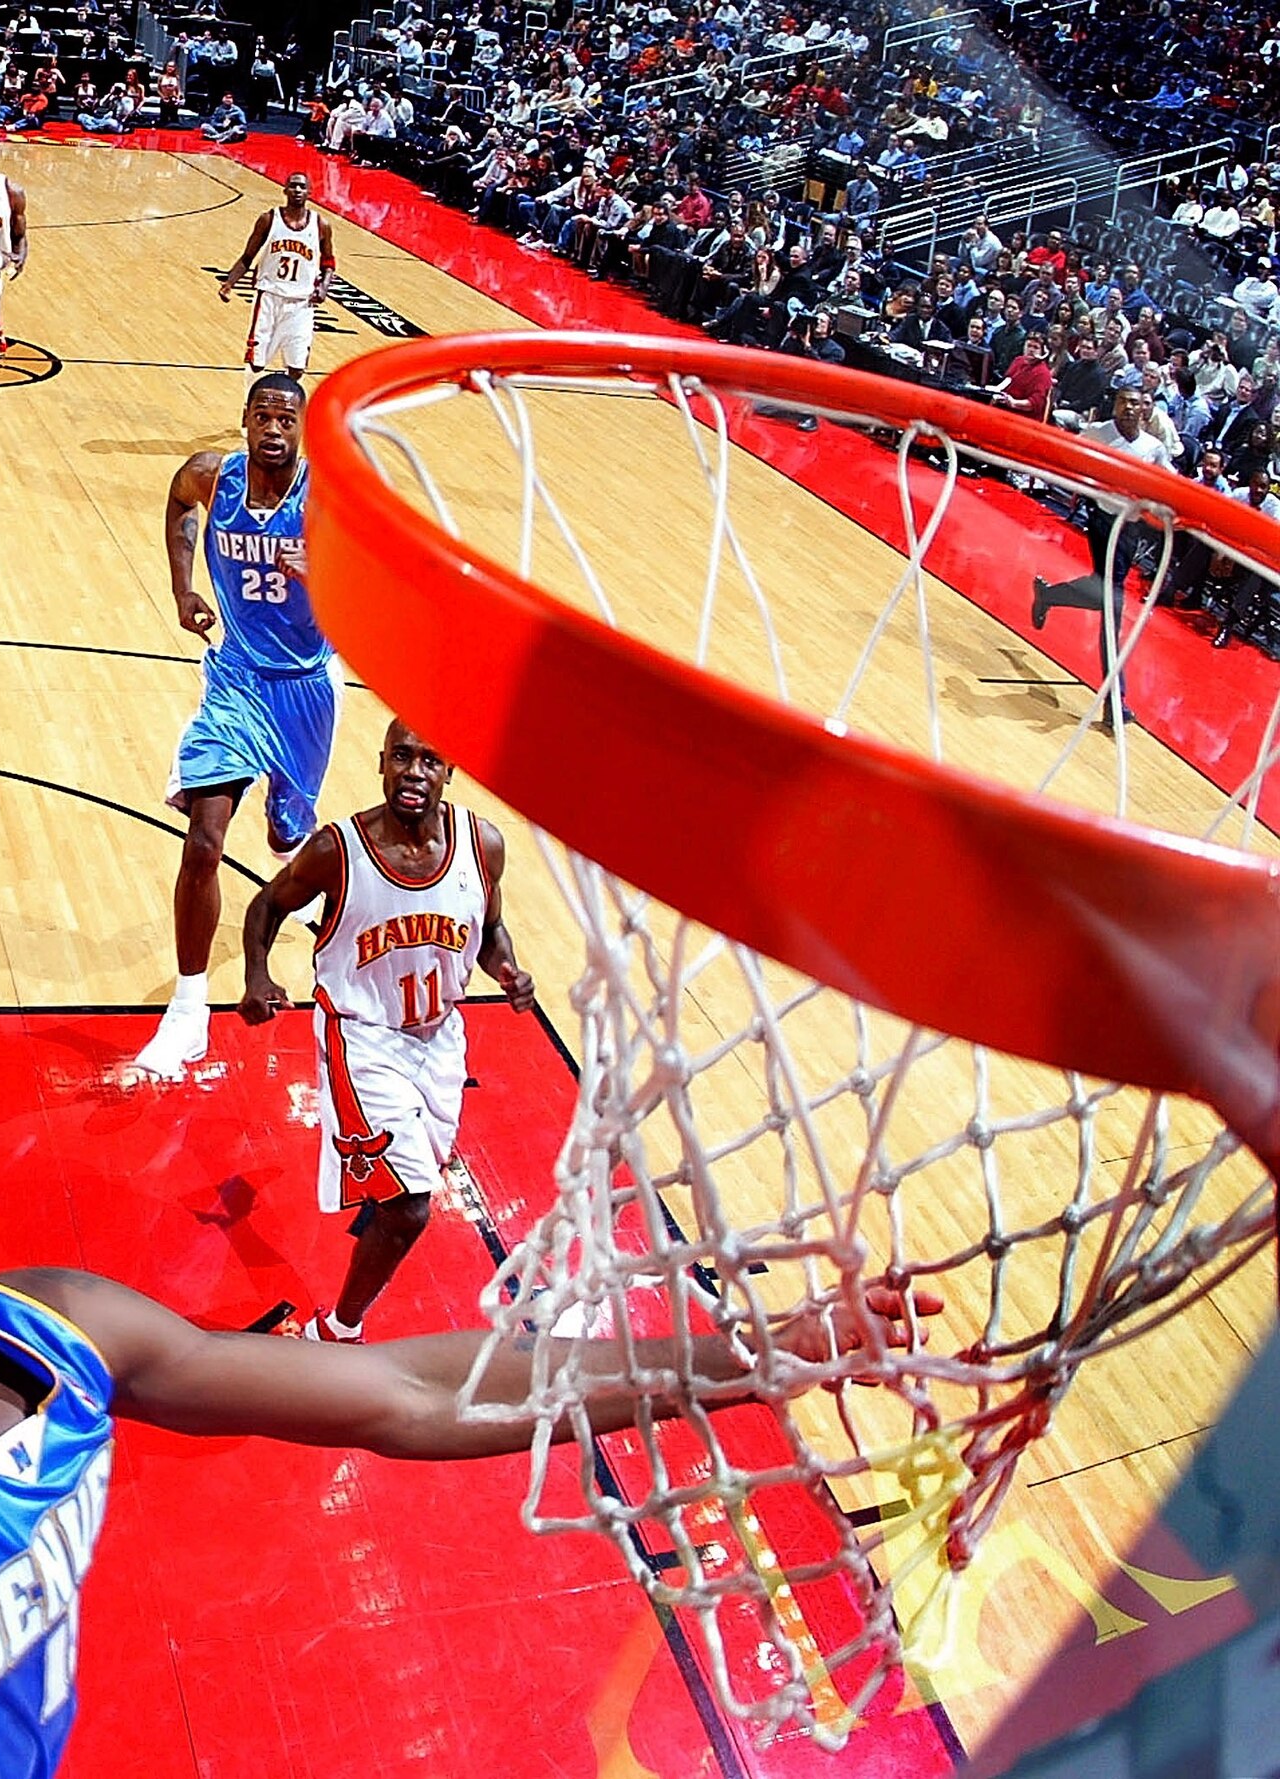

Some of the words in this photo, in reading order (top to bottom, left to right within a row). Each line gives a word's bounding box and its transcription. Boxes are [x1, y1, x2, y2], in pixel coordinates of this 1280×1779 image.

[271, 239, 313, 261] HAWKS
[277, 256, 299, 281] 31
[241, 569, 288, 604] 23
[356, 913, 469, 969] HAWKS
[399, 966, 445, 1029] 11
[40, 1612, 79, 1725] 1
